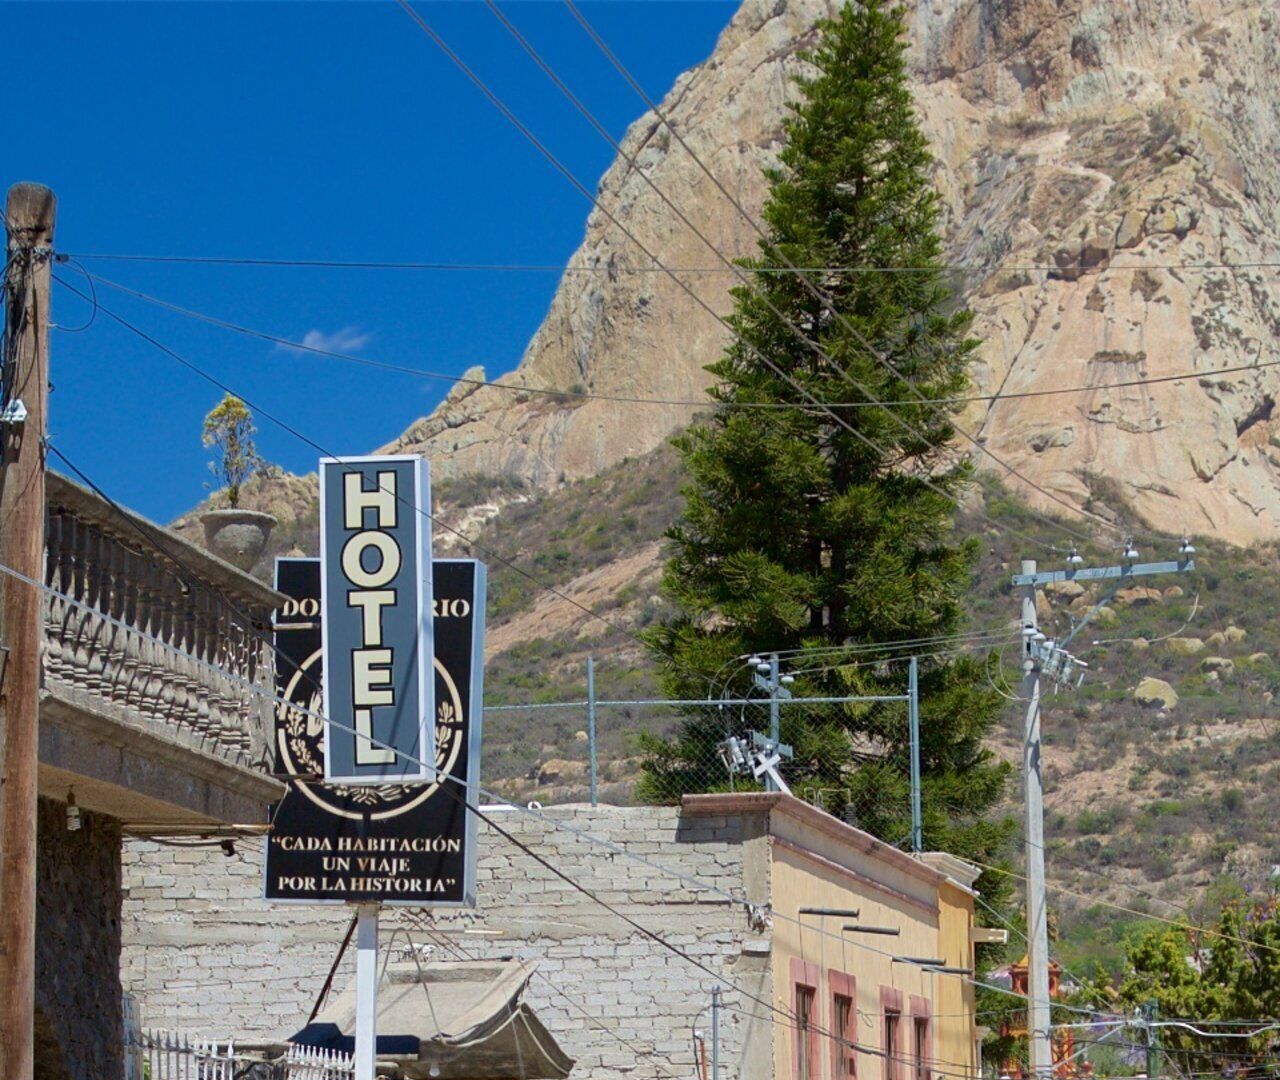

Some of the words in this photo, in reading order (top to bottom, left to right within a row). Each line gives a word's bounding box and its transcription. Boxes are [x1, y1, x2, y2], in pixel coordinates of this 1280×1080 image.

[281, 597, 322, 617] DO
[341, 471, 402, 766] HOTEL
[338, 834, 461, 853] HABITACIÓN
[322, 857, 350, 872] UN
[357, 857, 411, 876] VIAJE
[278, 876, 317, 891] POR
[322, 877, 346, 891] LA
